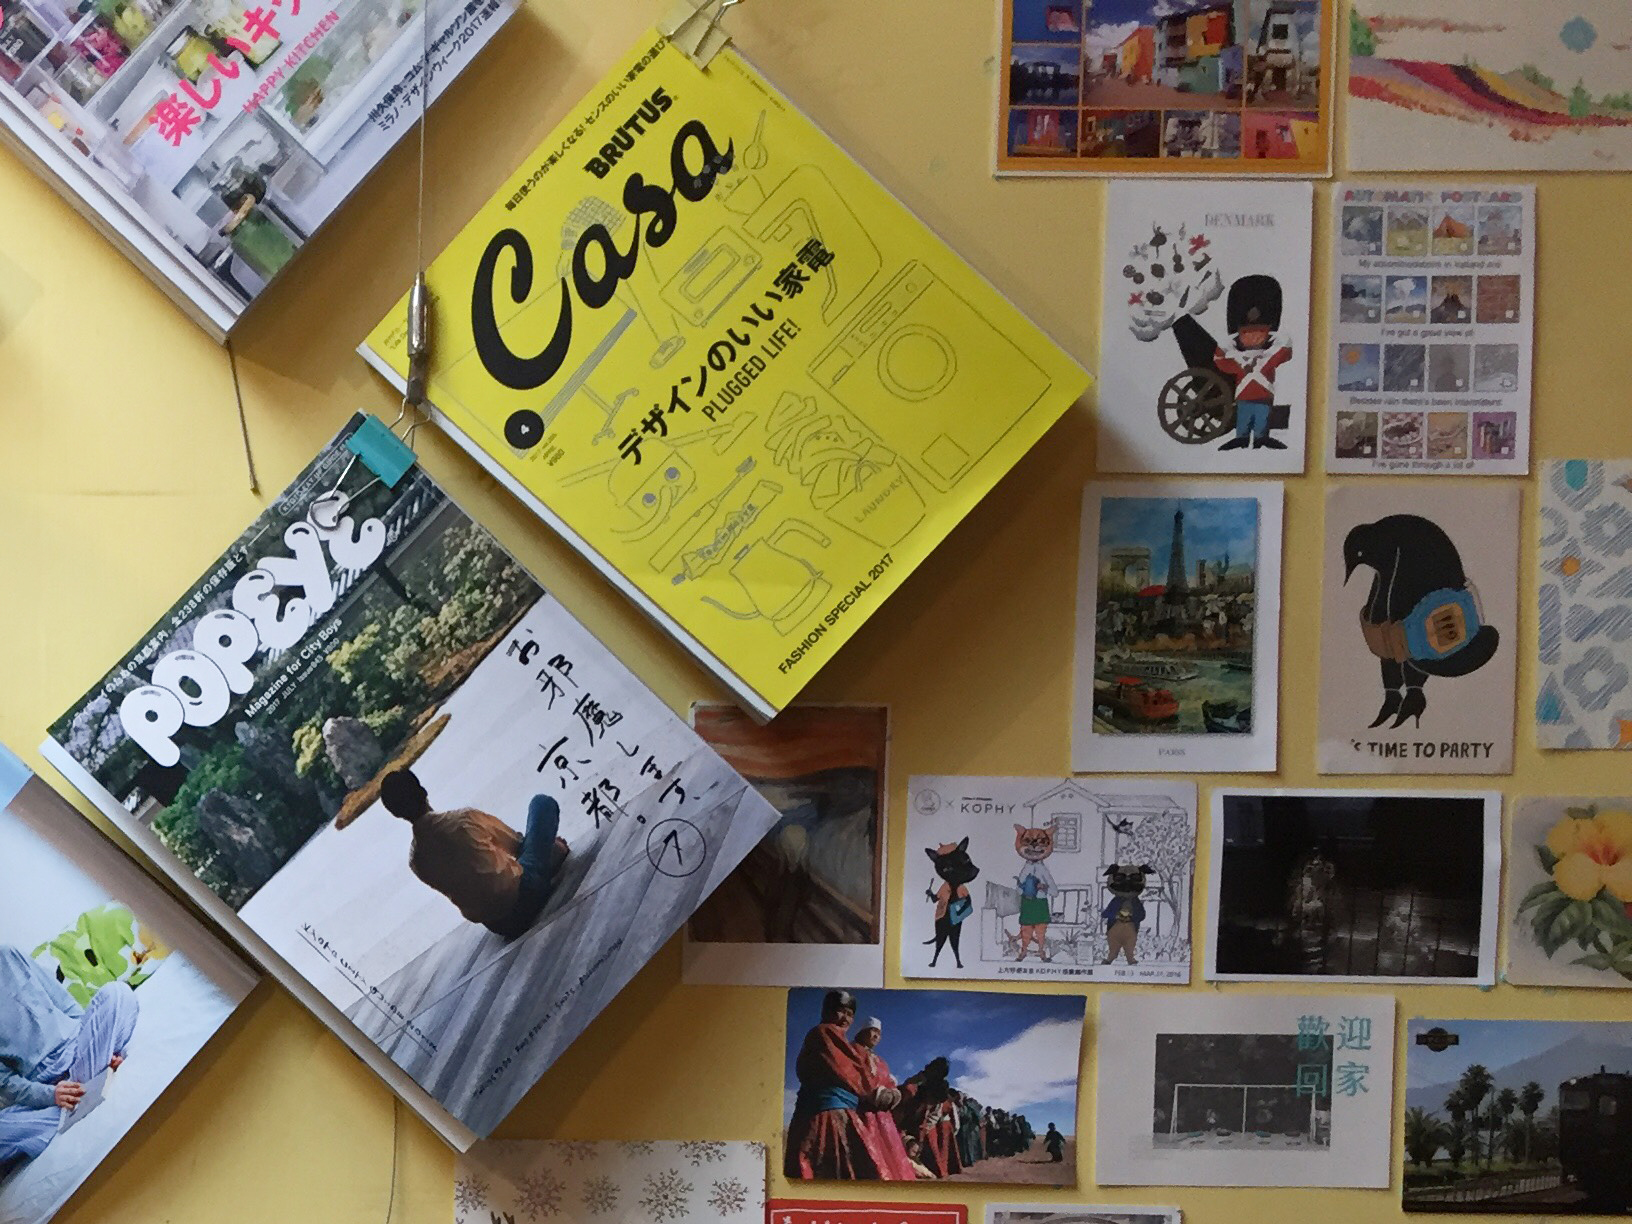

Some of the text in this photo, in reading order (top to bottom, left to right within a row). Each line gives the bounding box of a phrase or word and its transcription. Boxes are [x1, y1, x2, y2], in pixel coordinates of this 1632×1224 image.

[243, 10, 340, 114] HAPPY KITCHEN
[583, 85, 673, 180] BRUTUS
[471, 119, 735, 391] Casa
[1204, 213, 1276, 228] DENMARK
[617, 238, 837, 466] デザインのいい家電
[701, 317, 804, 423] PLUGGED LIFE!
[119, 489, 387, 768] POPEYE
[777, 553, 895, 675] FASHION SPECIAL 2017
[244, 618, 343, 718] Magazine for City Boys
[536, 736, 647, 830] 京都。
[1367, 741, 1408, 759] TIME
[1413, 741, 1436, 759] TO
[1439, 741, 1494, 759] PARTY
[960, 803, 1017, 815] KOPHY
[1296, 1060, 1370, 1097] 回家
[1297, 1014, 1372, 1051] 歡迎
